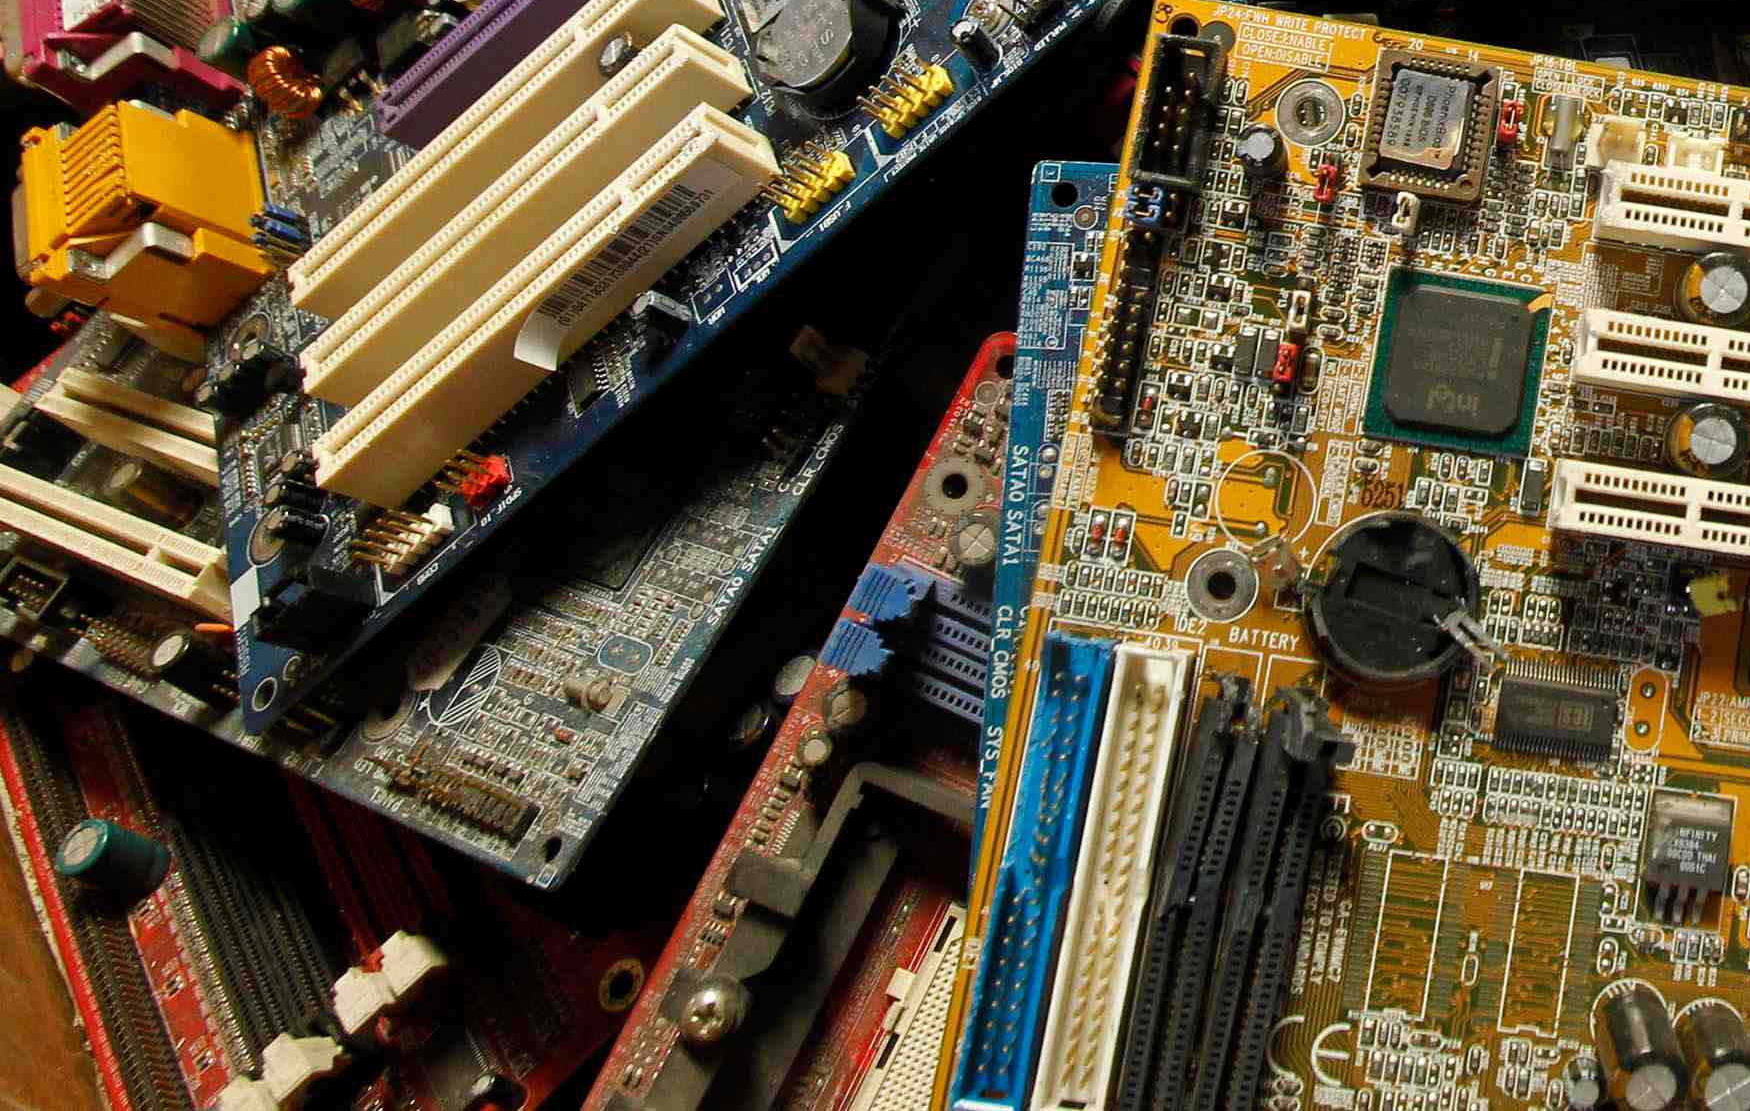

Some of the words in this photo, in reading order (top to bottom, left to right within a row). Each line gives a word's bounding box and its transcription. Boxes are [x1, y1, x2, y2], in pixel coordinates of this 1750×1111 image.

[1274, 12, 1310, 32] WRITE
[1313, 21, 1367, 38] PROTECT
[1005, 444, 1029, 501] SATA0
[1000, 508, 1019, 565] SATA1
[989, 604, 1014, 699] CLR_CMOS
[1226, 625, 1300, 653] BATTERY
[978, 724, 1004, 811] SYS_FAN
